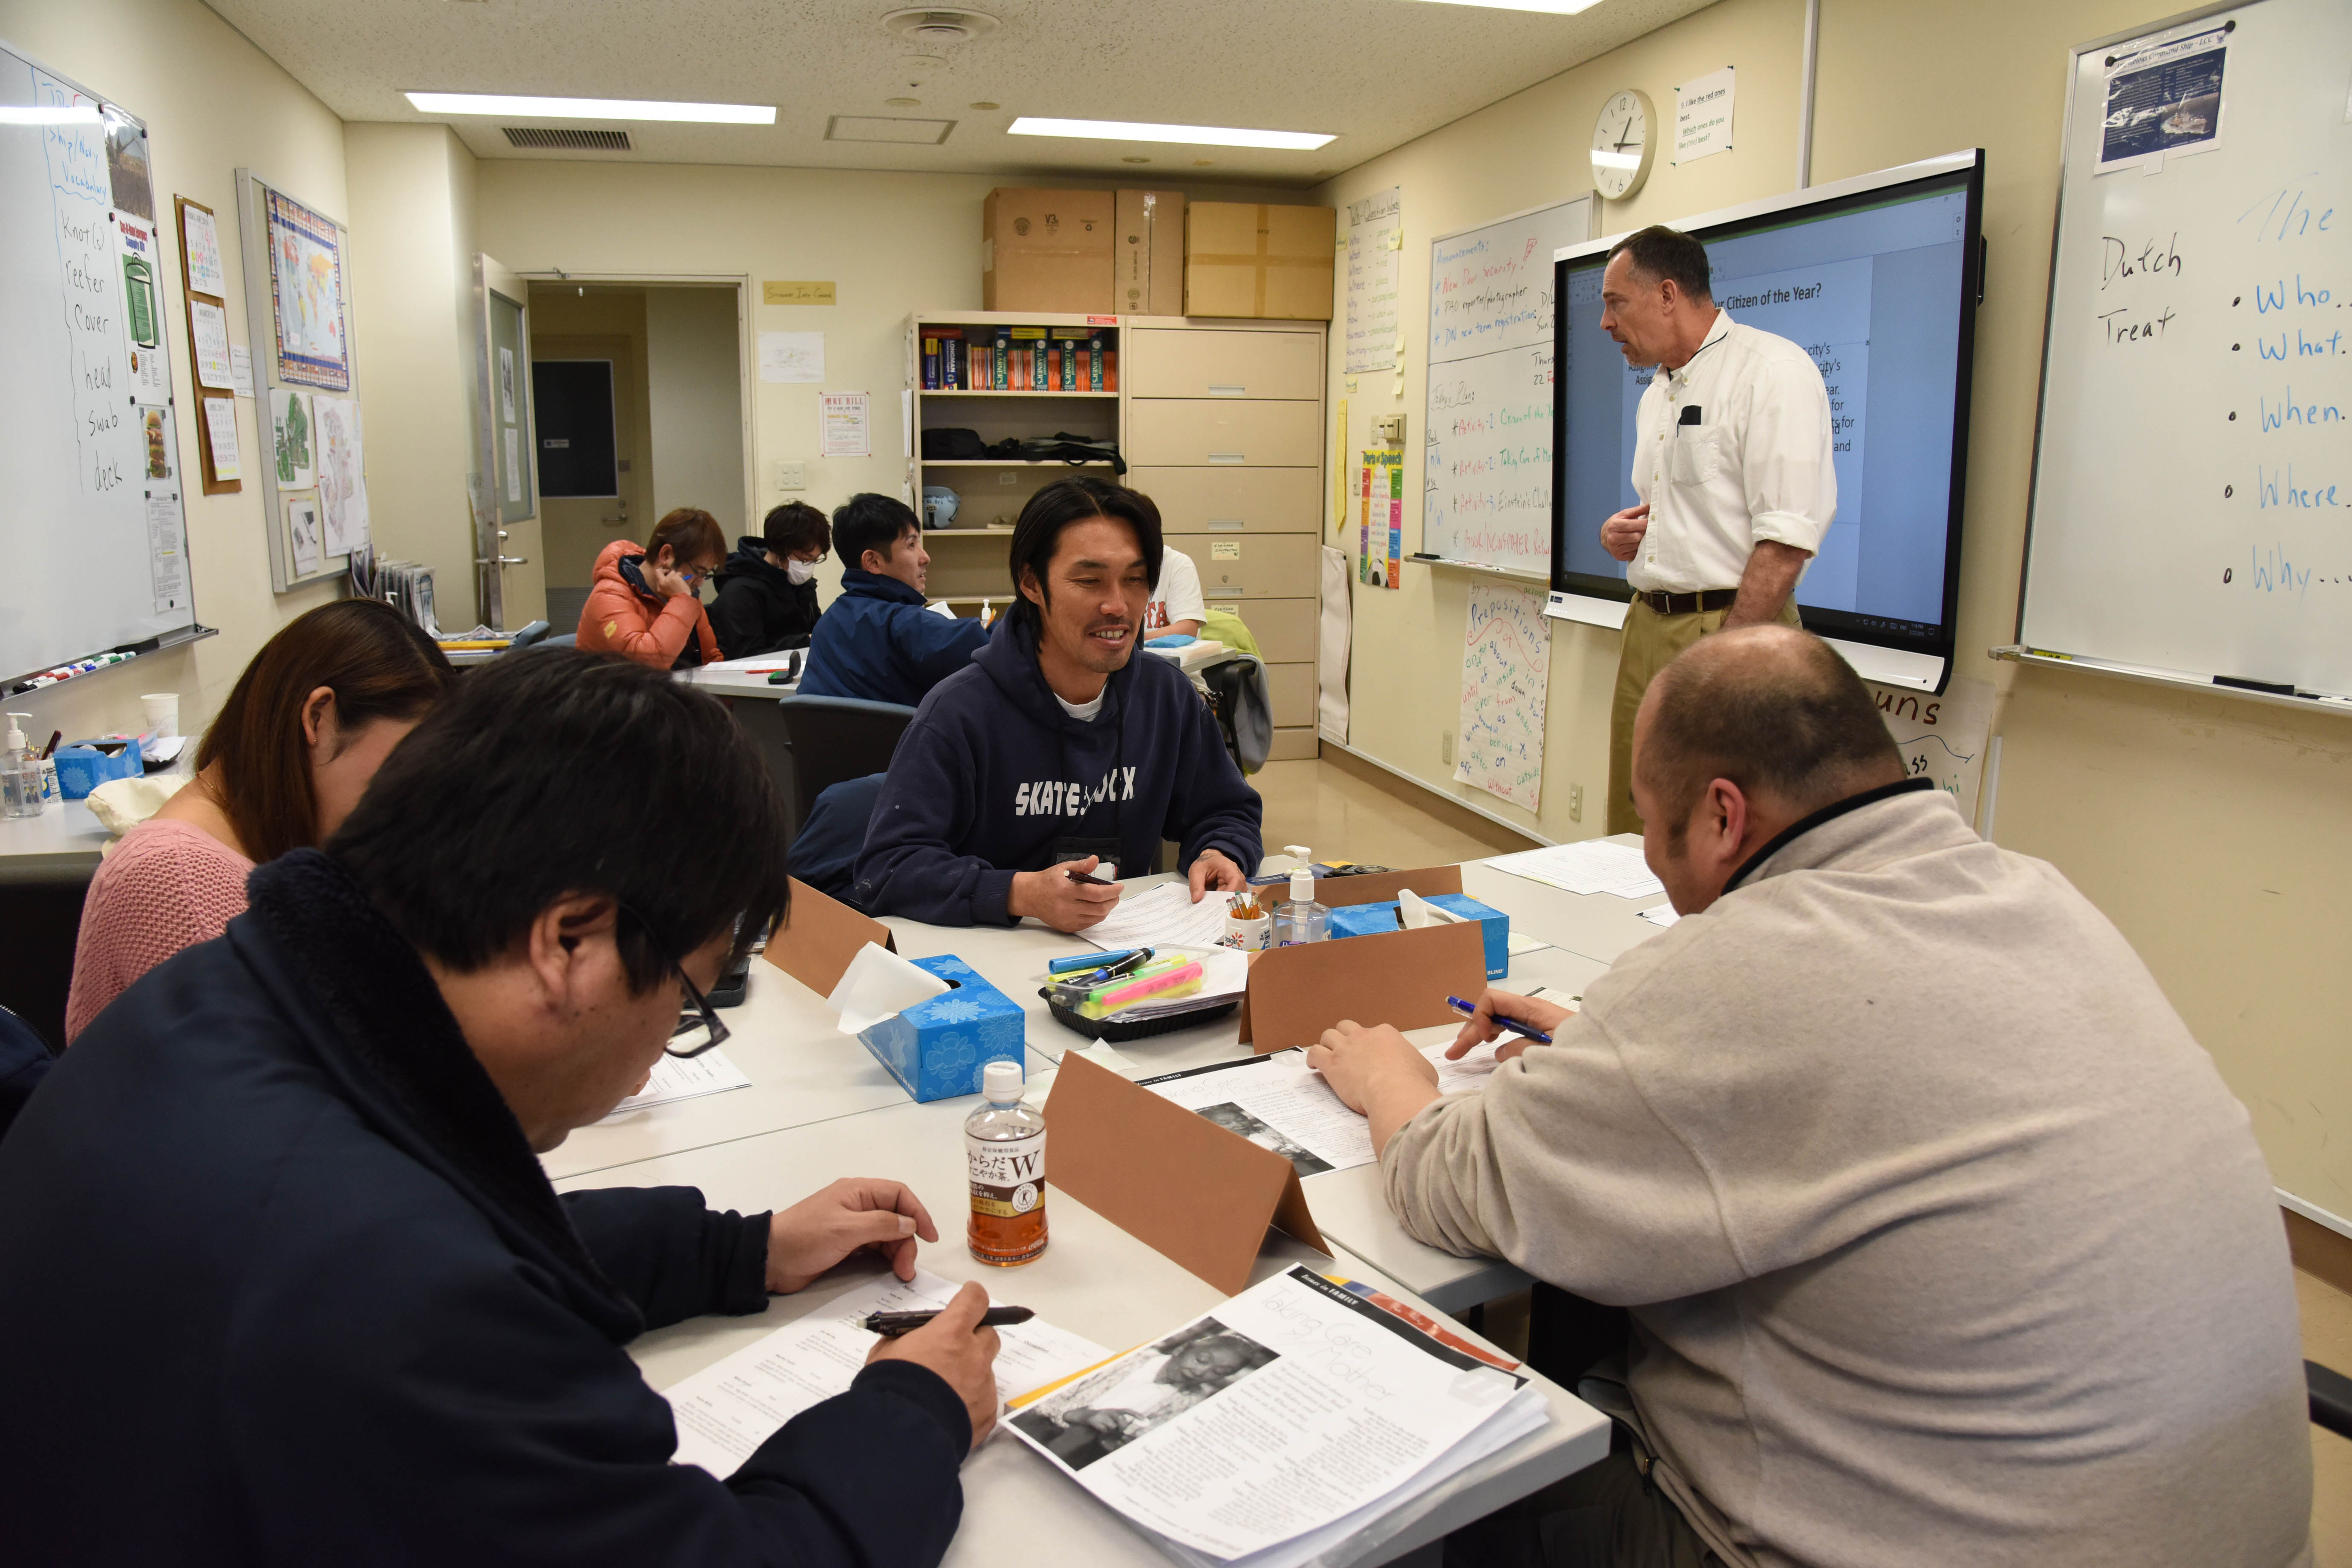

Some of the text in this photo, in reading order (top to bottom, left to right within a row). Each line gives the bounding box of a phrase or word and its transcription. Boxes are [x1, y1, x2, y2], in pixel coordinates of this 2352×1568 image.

[2149, 47, 2178, 59] Command
[2180, 42, 2193, 52] Ship
[2199, 36, 2212, 46] LCC
[1705, 92, 1713, 101] red
[1714, 88, 1725, 98] ones
[1620, 98, 1626, 112] 12
[1680, 114, 1691, 122] best.
[1682, 125, 1696, 136] Which
[1716, 116, 1724, 128] you
[1698, 133, 1710, 144] best?
[1618, 179, 1623, 192] 6
[2101, 231, 2181, 291] Dutch
[66, 254, 104, 293] reefer
[1443, 277, 1457, 294] New
[1727, 282, 1822, 310] Citizen of the Year?
[75, 303, 109, 334] Cover
[1476, 320, 1492, 333] term
[2098, 306, 2176, 346] Treat
[1807, 342, 1830, 358] city's
[83, 351, 111, 391] head
[1818, 359, 1841, 373] city's
[1534, 375, 1545, 386] 22
[1841, 415, 1854, 429] for
[1833, 439, 1851, 452] and
[1363, 452, 1376, 465] Parts
[1381, 452, 1402, 468] Speech
[95, 450, 122, 490] deck
[1472, 583, 1481, 594] by
[1524, 586, 1545, 597] across
[1471, 600, 1542, 654] Prepositions
[1503, 634, 1512, 648] at
[1466, 654, 1478, 668] on
[1490, 640, 1507, 668] about
[1481, 666, 1488, 683] of
[1496, 663, 1516, 687] inside
[1525, 669, 1534, 688] in
[1462, 679, 1478, 703] until
[1511, 680, 1525, 699] down
[1475, 695, 1492, 712] over
[1496, 692, 1516, 708] from
[1497, 715, 1506, 724] as
[1516, 707, 1533, 736] under
[1465, 723, 1479, 742] with
[1490, 732, 1513, 753] behind
[1461, 761, 1472, 775] off
[1471, 751, 1488, 771] after
[1496, 757, 1506, 767] on
[1517, 767, 1540, 786] outside
[1487, 777, 1512, 796] without
[1015, 781, 1080, 816] SKATE
[1160, 1072, 1182, 1083] FAMILY
[967, 1149, 1040, 1179] からだ W
[1301, 1274, 1320, 1287] Issues
[1328, 1288, 1359, 1305] FAMILY
[1261, 1285, 1372, 1359] Taking Care
